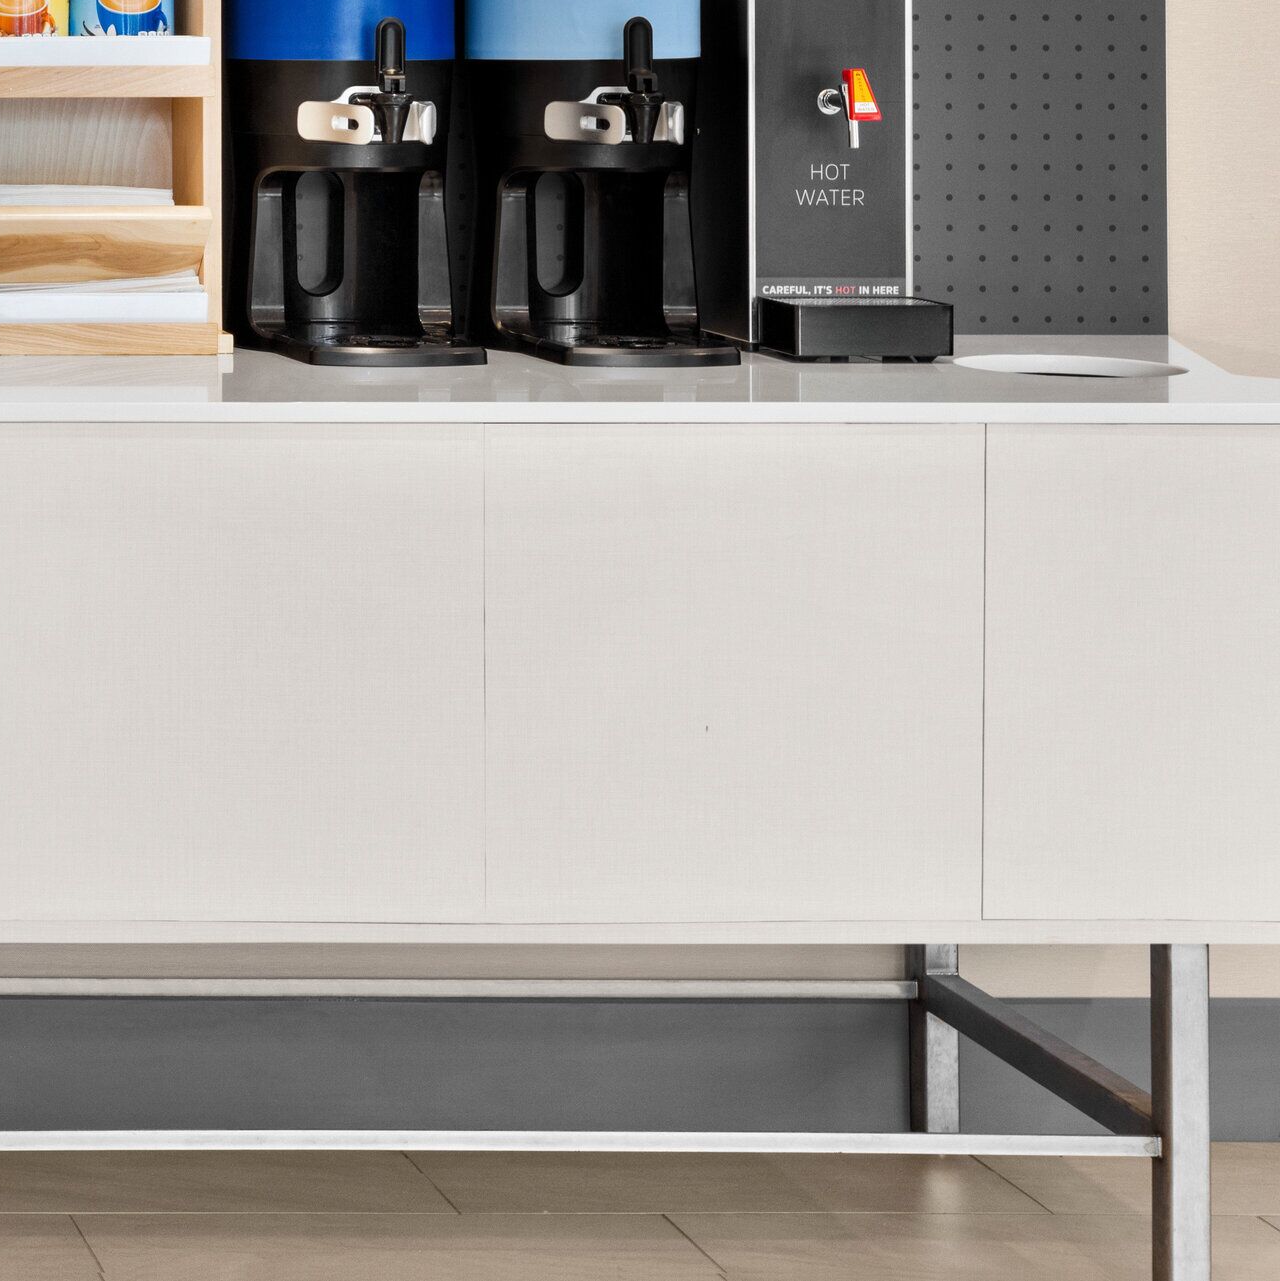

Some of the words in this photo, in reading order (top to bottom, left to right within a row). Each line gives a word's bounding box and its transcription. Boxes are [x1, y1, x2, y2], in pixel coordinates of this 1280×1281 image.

[810, 163, 850, 180] HOT
[795, 189, 865, 206] WATER
[762, 285, 811, 296] CAREFUL,
[813, 285, 833, 295] IT'S
[835, 285, 856, 295] HOT
[858, 285, 870, 295] IN
[872, 285, 900, 295] HERE
